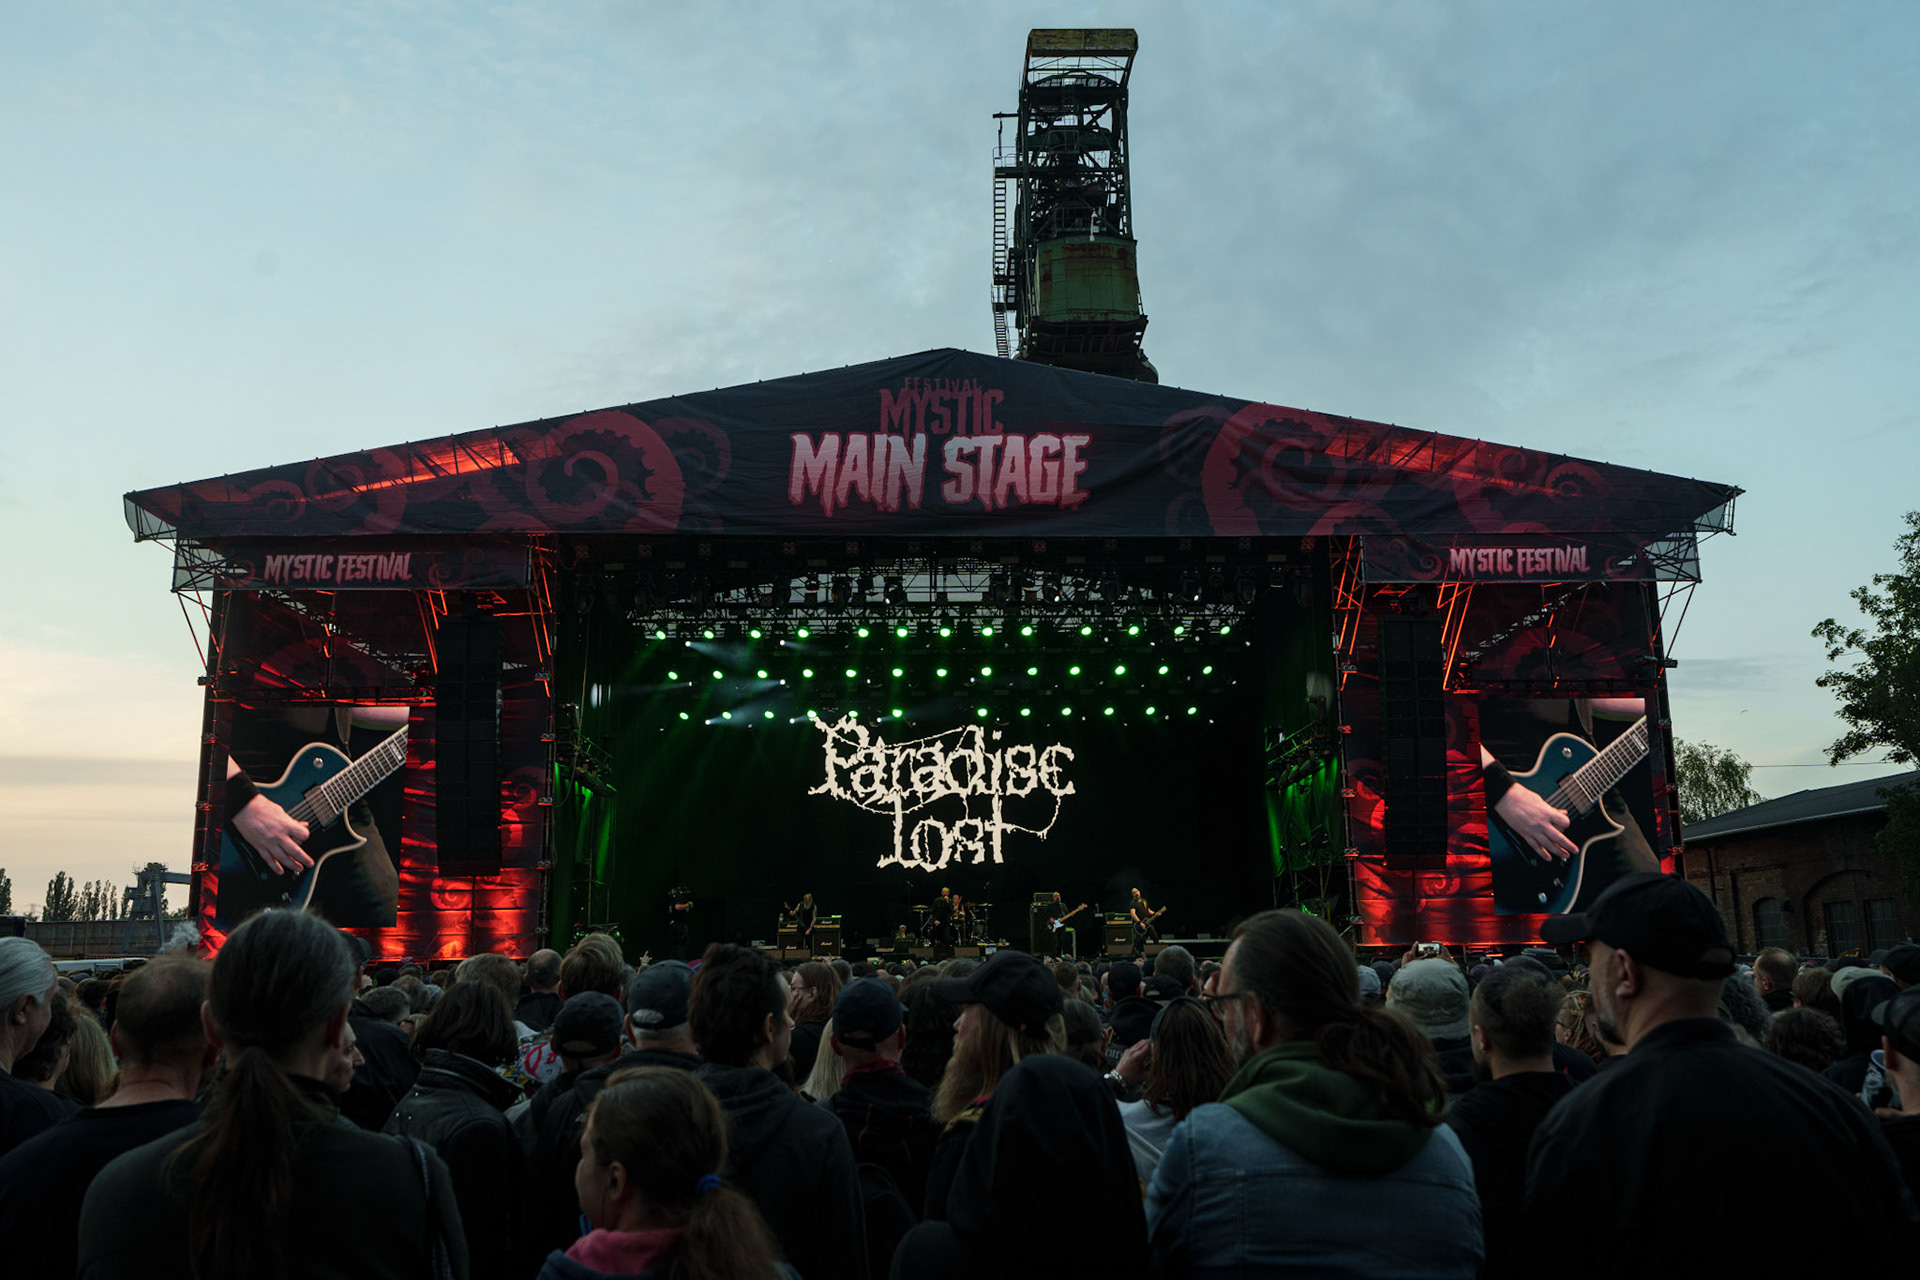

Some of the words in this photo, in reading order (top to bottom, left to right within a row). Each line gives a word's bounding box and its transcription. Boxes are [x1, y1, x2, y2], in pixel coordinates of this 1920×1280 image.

[904, 377, 982, 391] FESTIVAL
[880, 388, 1004, 436] MYSTIC
[789, 432, 928, 517] MAIN
[941, 432, 1092, 512] STAGE
[264, 554, 334, 585] MYSTIC
[336, 551, 413, 585] FESTIVAL
[1450, 548, 1514, 578] MYSTIC
[1516, 544, 1590, 578] FESTIVAL
